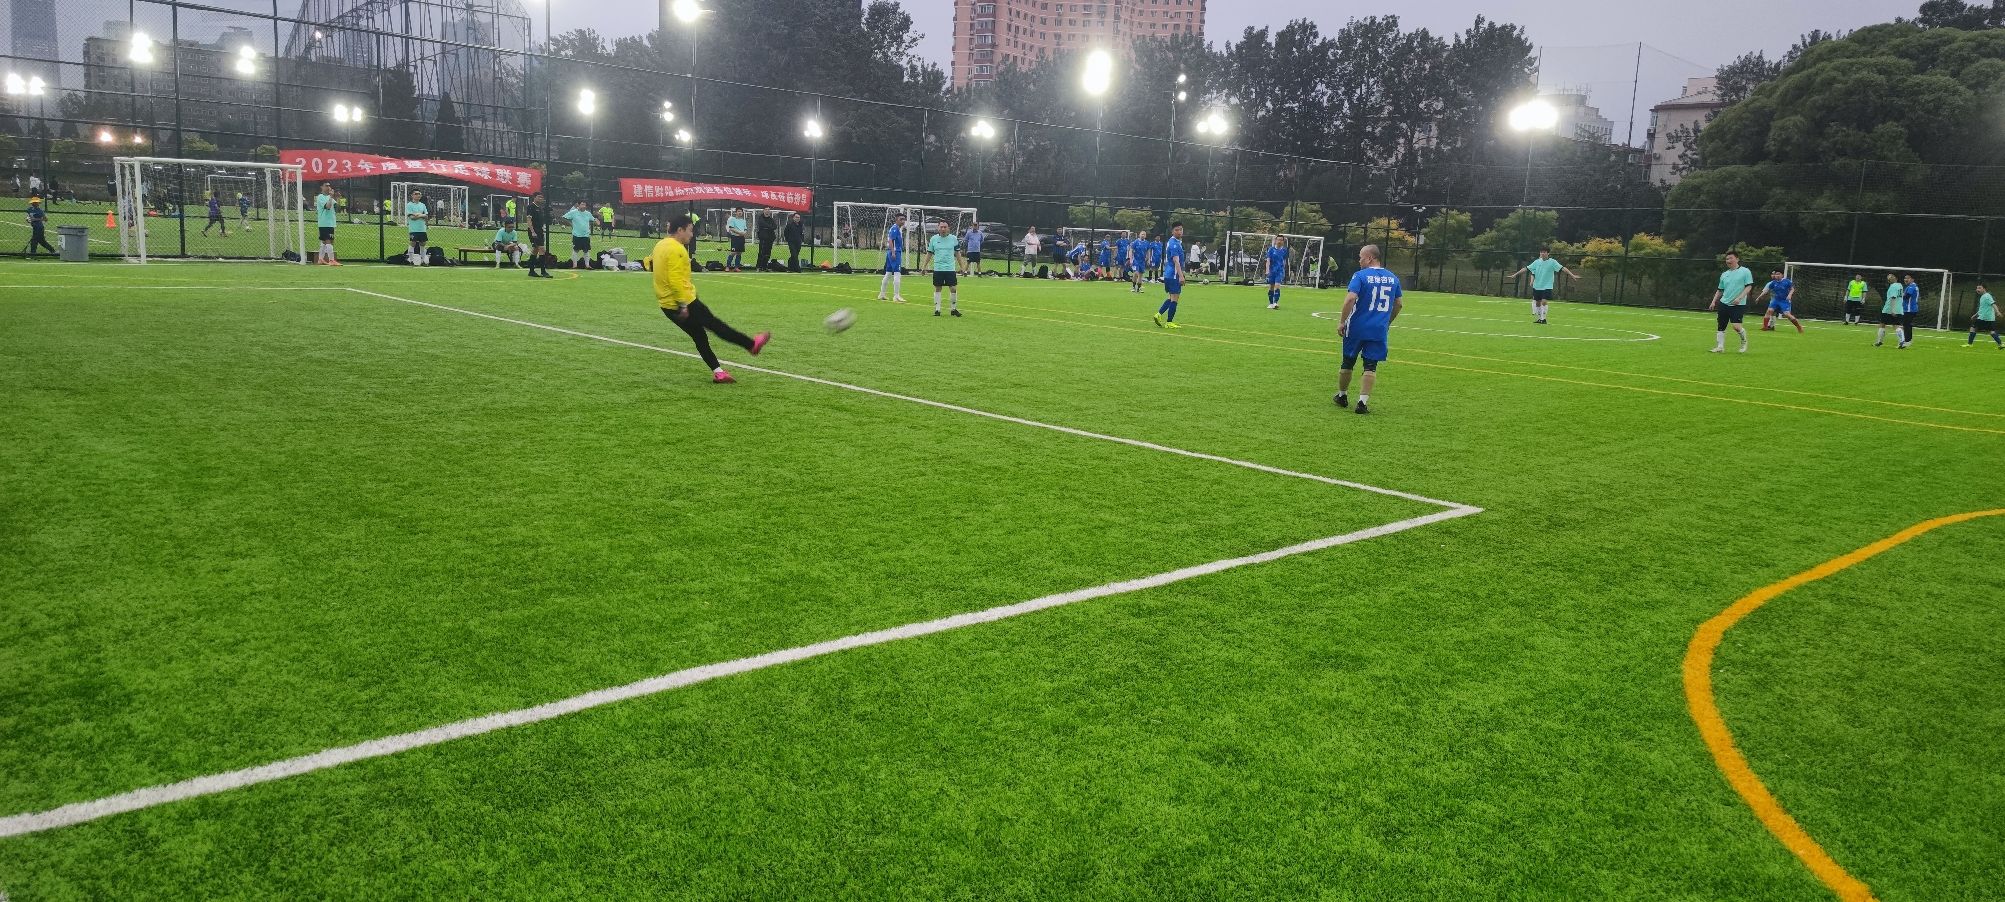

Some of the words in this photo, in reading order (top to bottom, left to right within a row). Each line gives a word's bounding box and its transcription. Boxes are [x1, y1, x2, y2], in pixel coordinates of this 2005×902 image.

[295, 157, 532, 189] 2023年度建行足球联赛
[1368, 286, 1392, 312] 15
